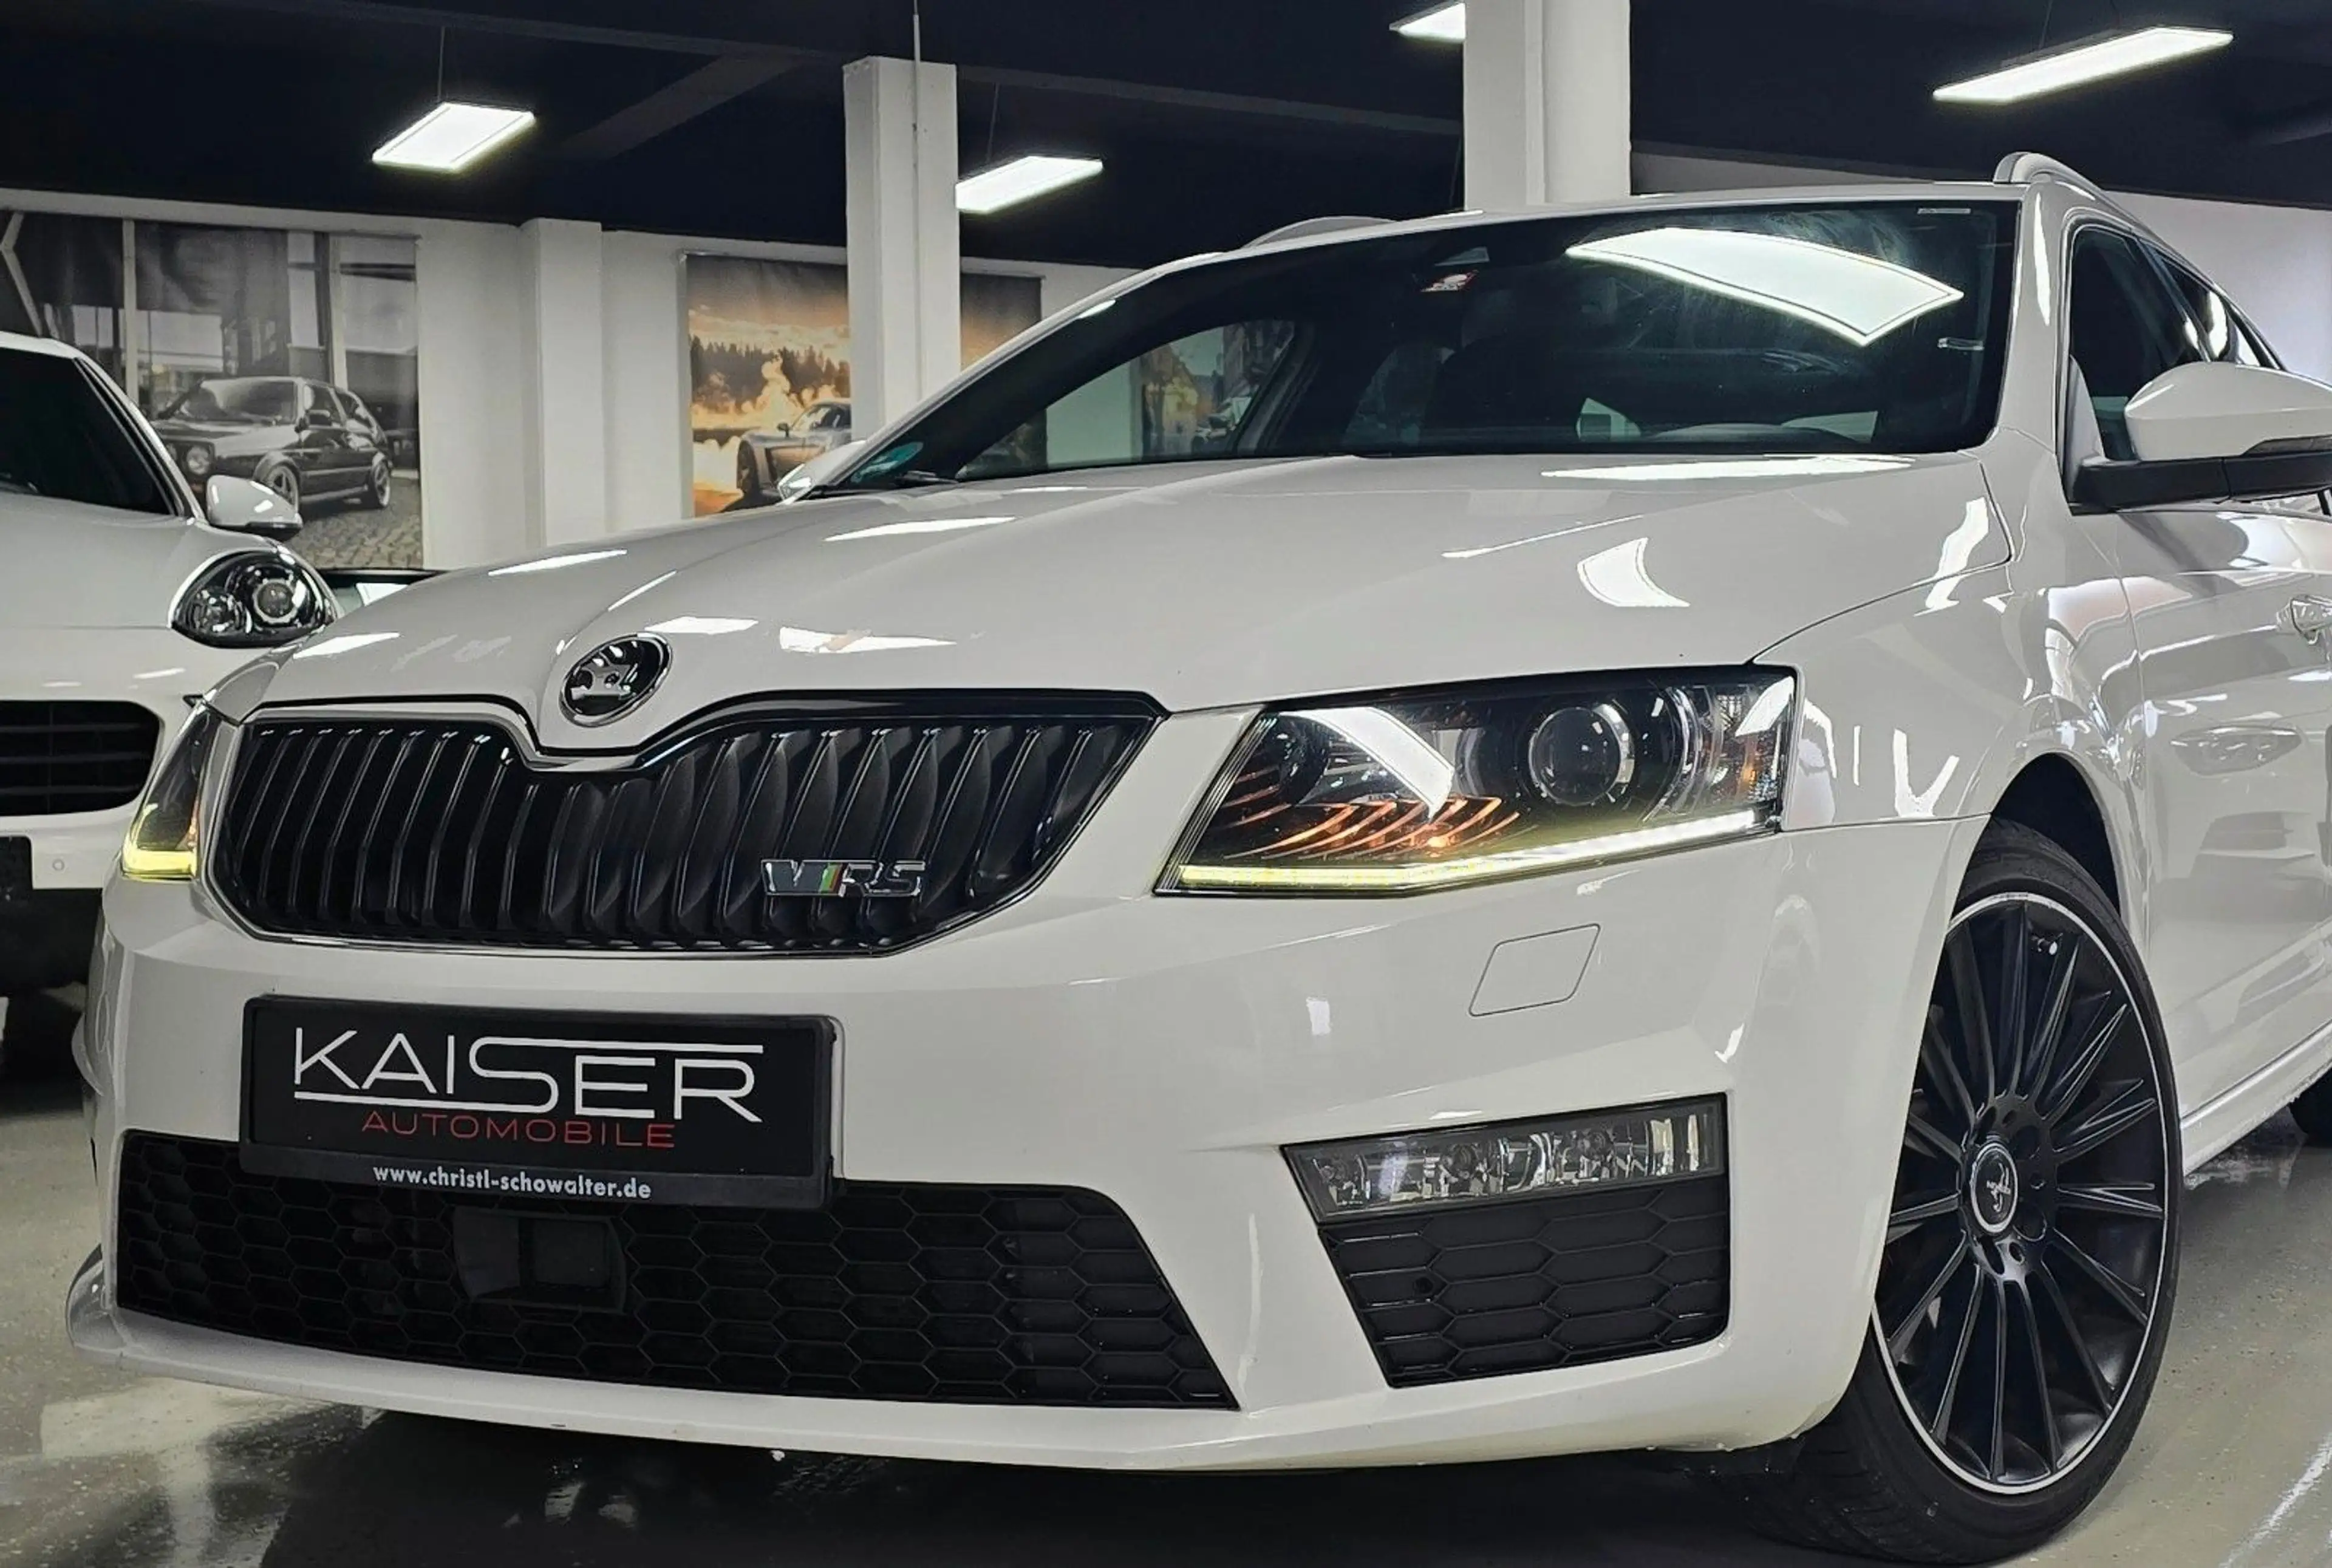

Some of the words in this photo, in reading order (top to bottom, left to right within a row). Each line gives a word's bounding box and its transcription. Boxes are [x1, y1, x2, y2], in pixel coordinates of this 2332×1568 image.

[295, 1027, 763, 1122] KAISER
[362, 1111, 675, 1148] AUTOMOBILE
[373, 1165, 651, 1199] www.christl-schowalter.de
